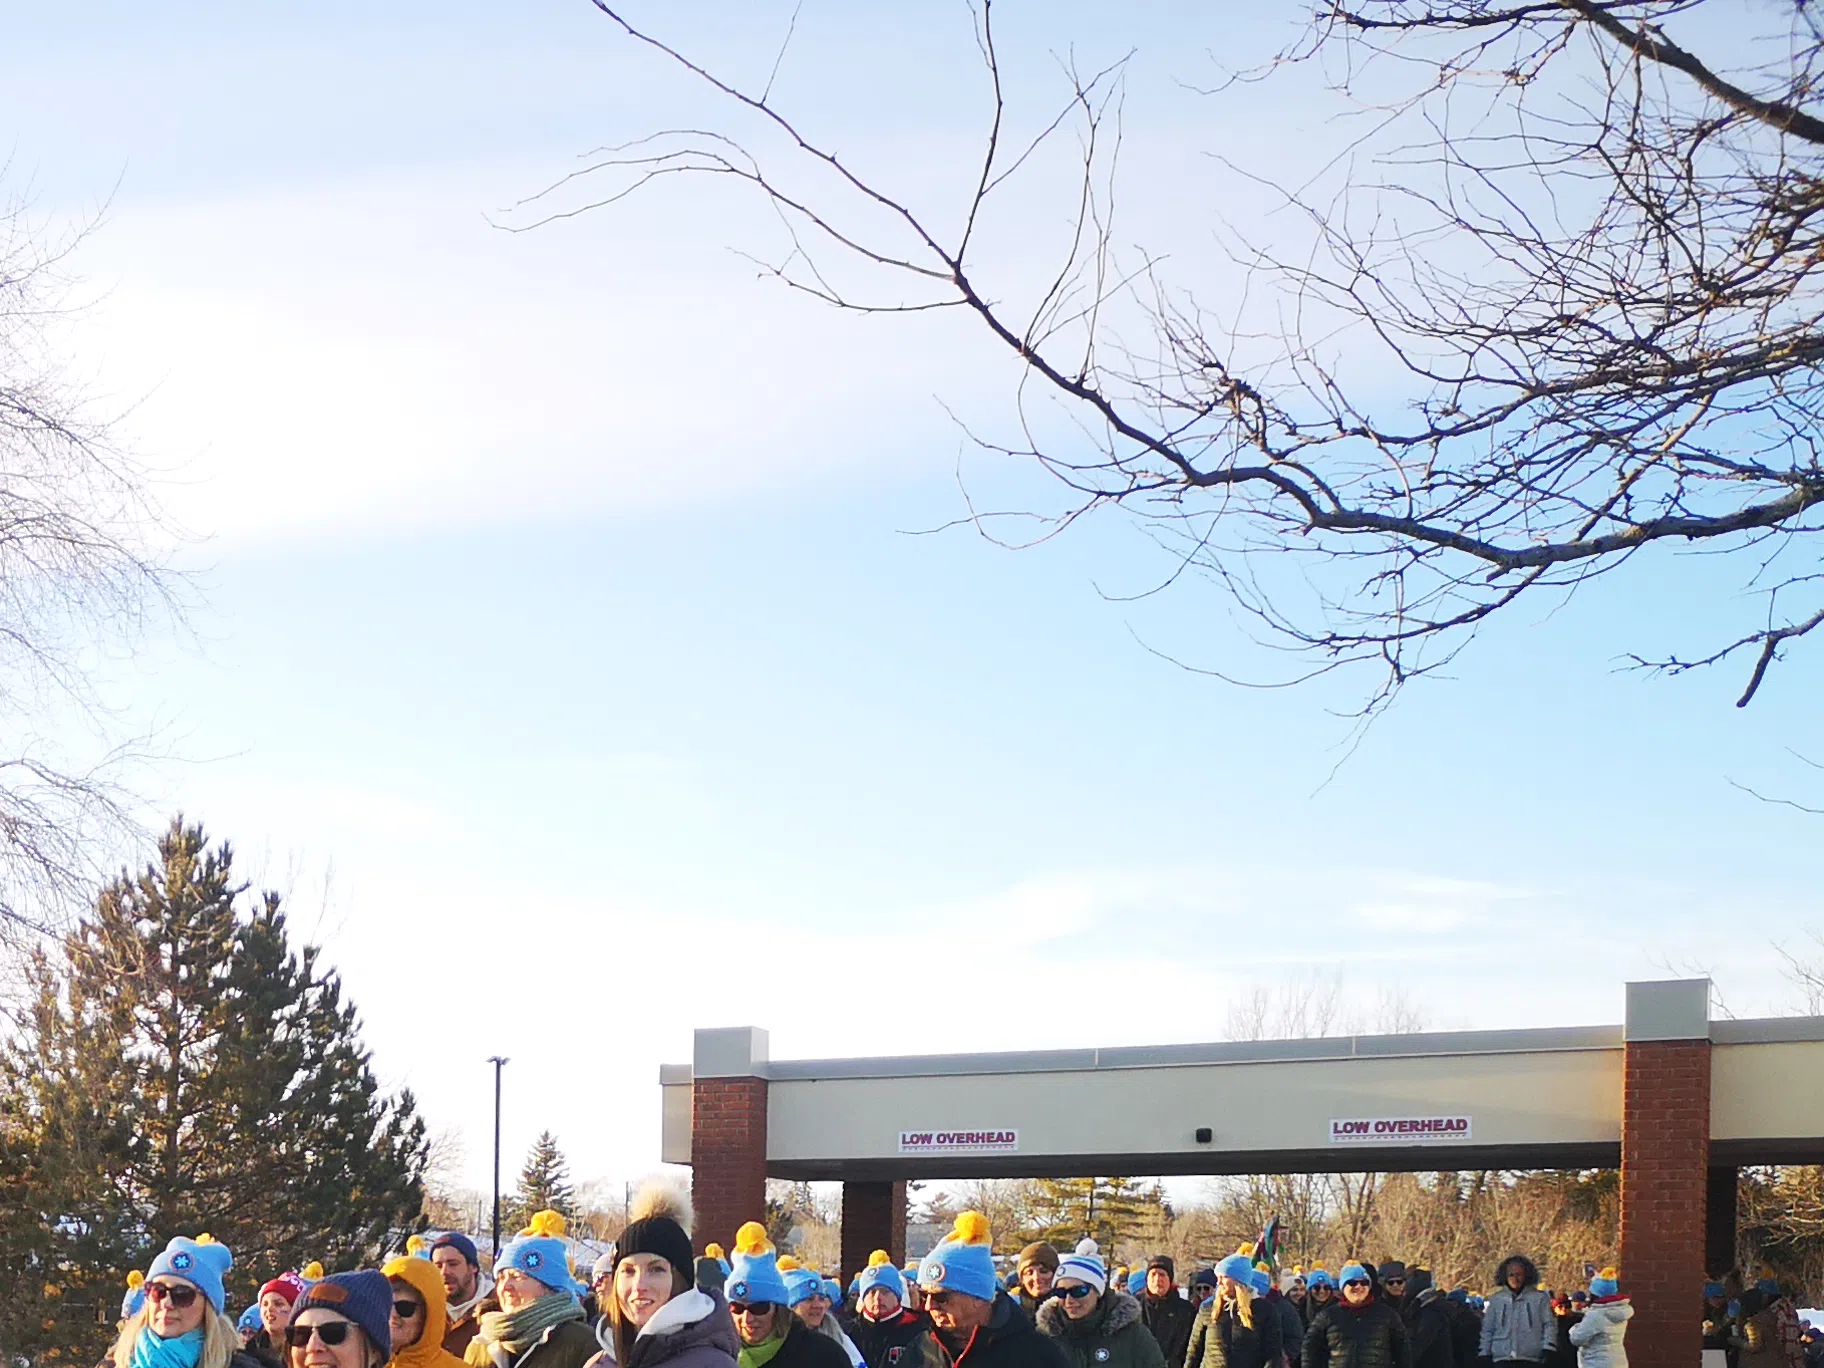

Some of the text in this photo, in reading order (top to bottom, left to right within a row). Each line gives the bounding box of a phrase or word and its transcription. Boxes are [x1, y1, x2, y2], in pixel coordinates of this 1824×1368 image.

[1333, 1119, 1468, 1134] LOW OVERHEAD
[902, 1132, 1015, 1145] LOW OVERHEAD
